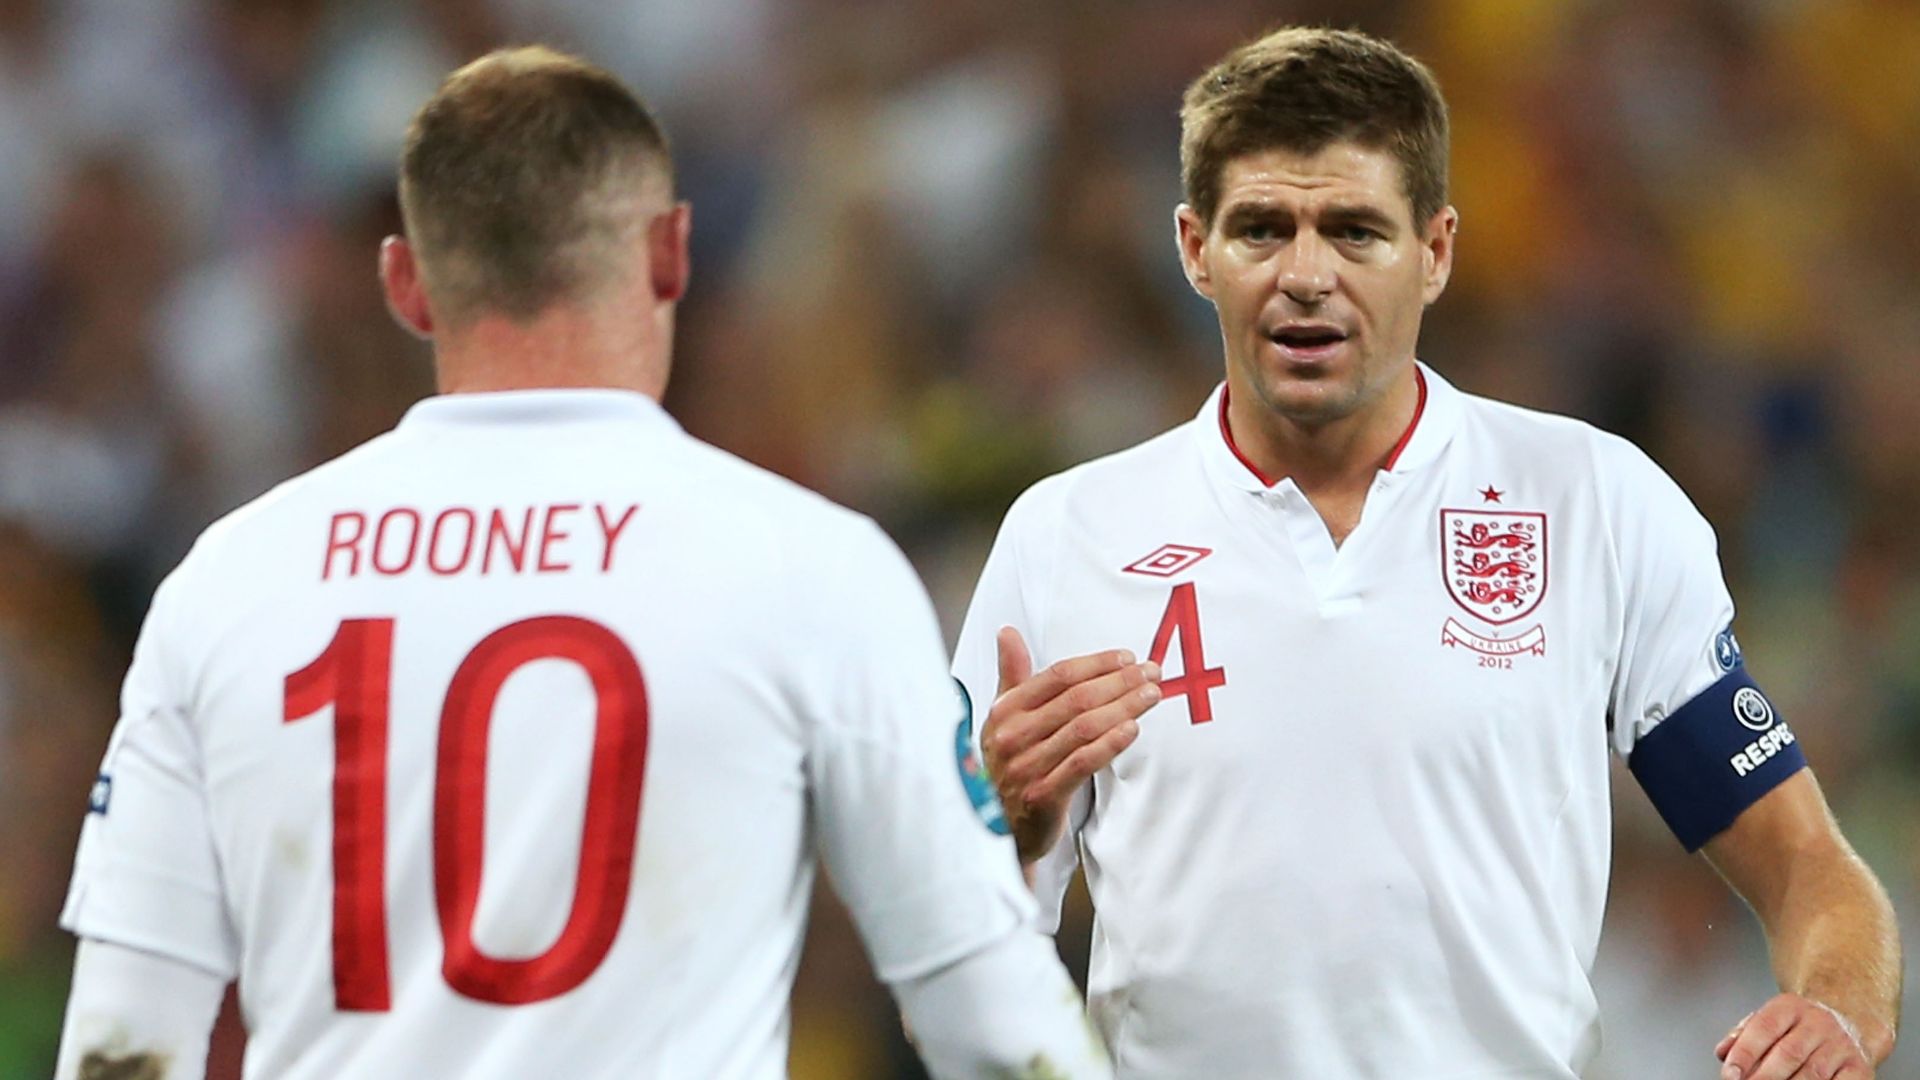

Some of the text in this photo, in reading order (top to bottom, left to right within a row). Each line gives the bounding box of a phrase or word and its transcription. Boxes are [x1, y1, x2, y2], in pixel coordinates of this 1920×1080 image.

[321, 503, 639, 581] ROONEY
[1147, 581, 1226, 725] 4
[1470, 637, 1521, 653] UKRAINE
[1478, 656, 1513, 669] 2012
[283, 614, 652, 1012] 10
